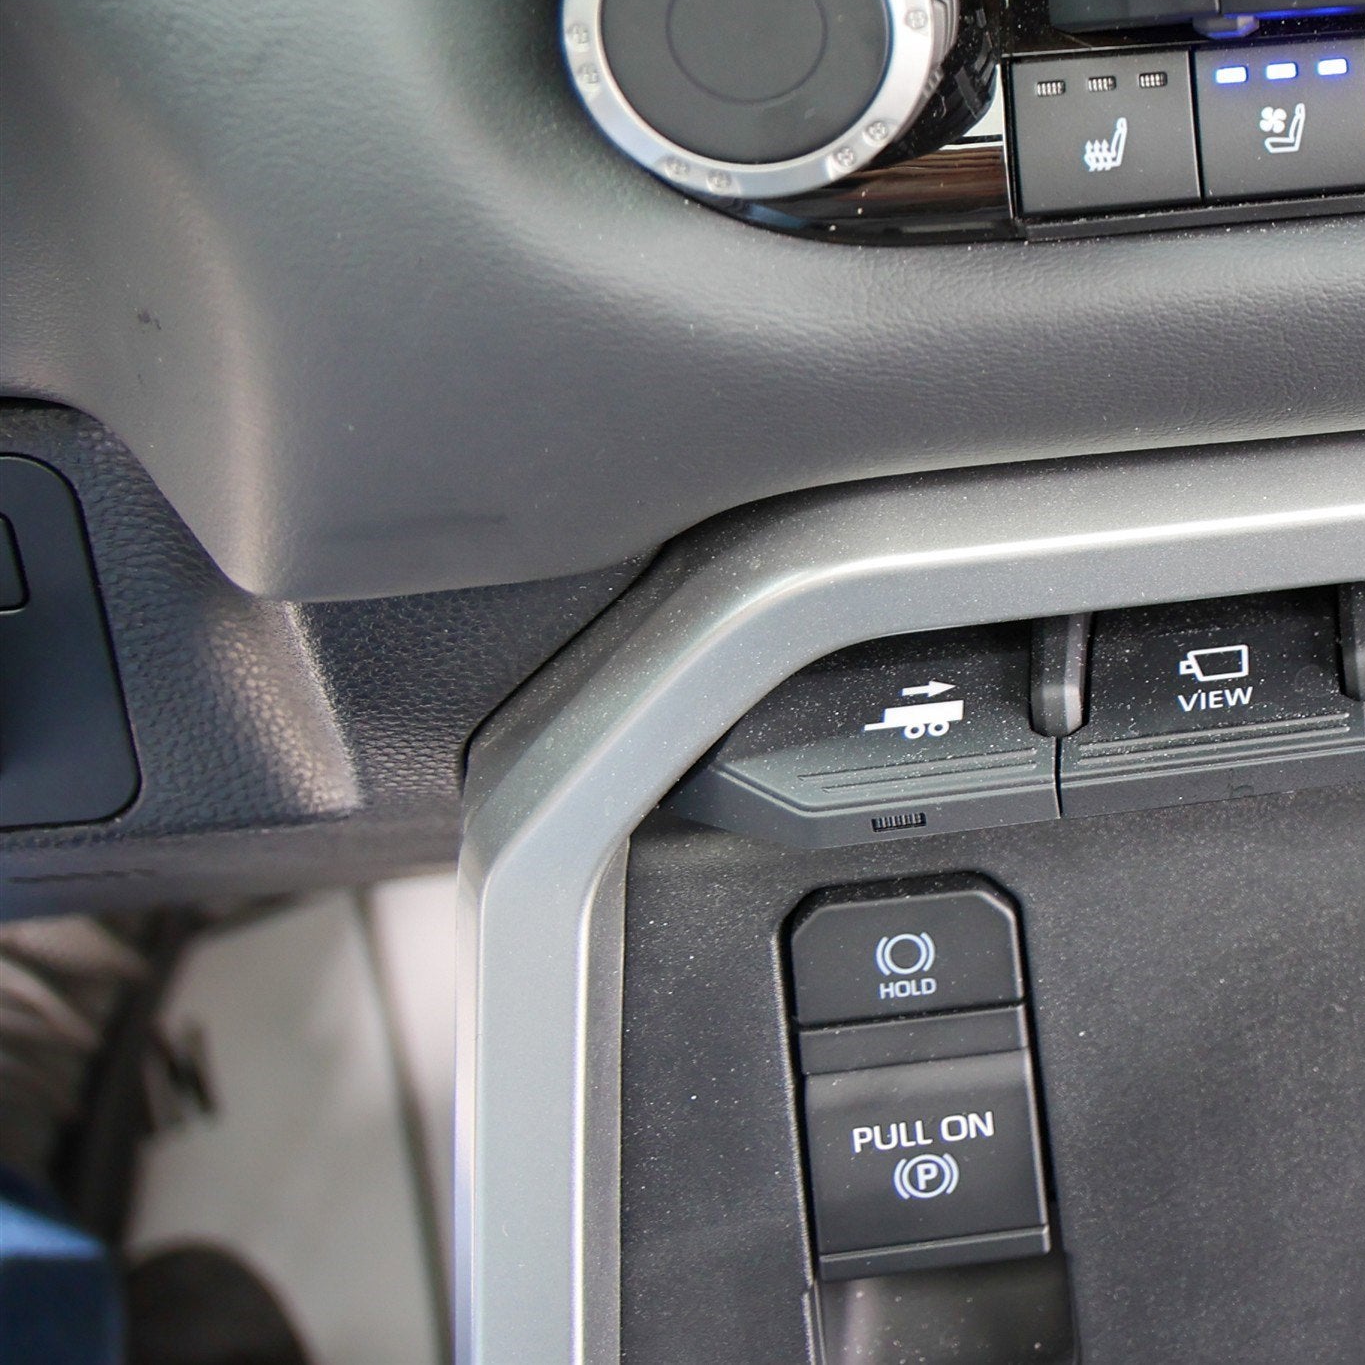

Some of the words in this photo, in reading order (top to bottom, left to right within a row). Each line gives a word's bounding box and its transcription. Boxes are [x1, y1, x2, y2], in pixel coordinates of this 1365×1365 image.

[1177, 686, 1253, 712] VIEW
[879, 977, 937, 1000] HOLD
[852, 1121, 933, 1154] PULL
[940, 1111, 995, 1141] ON
